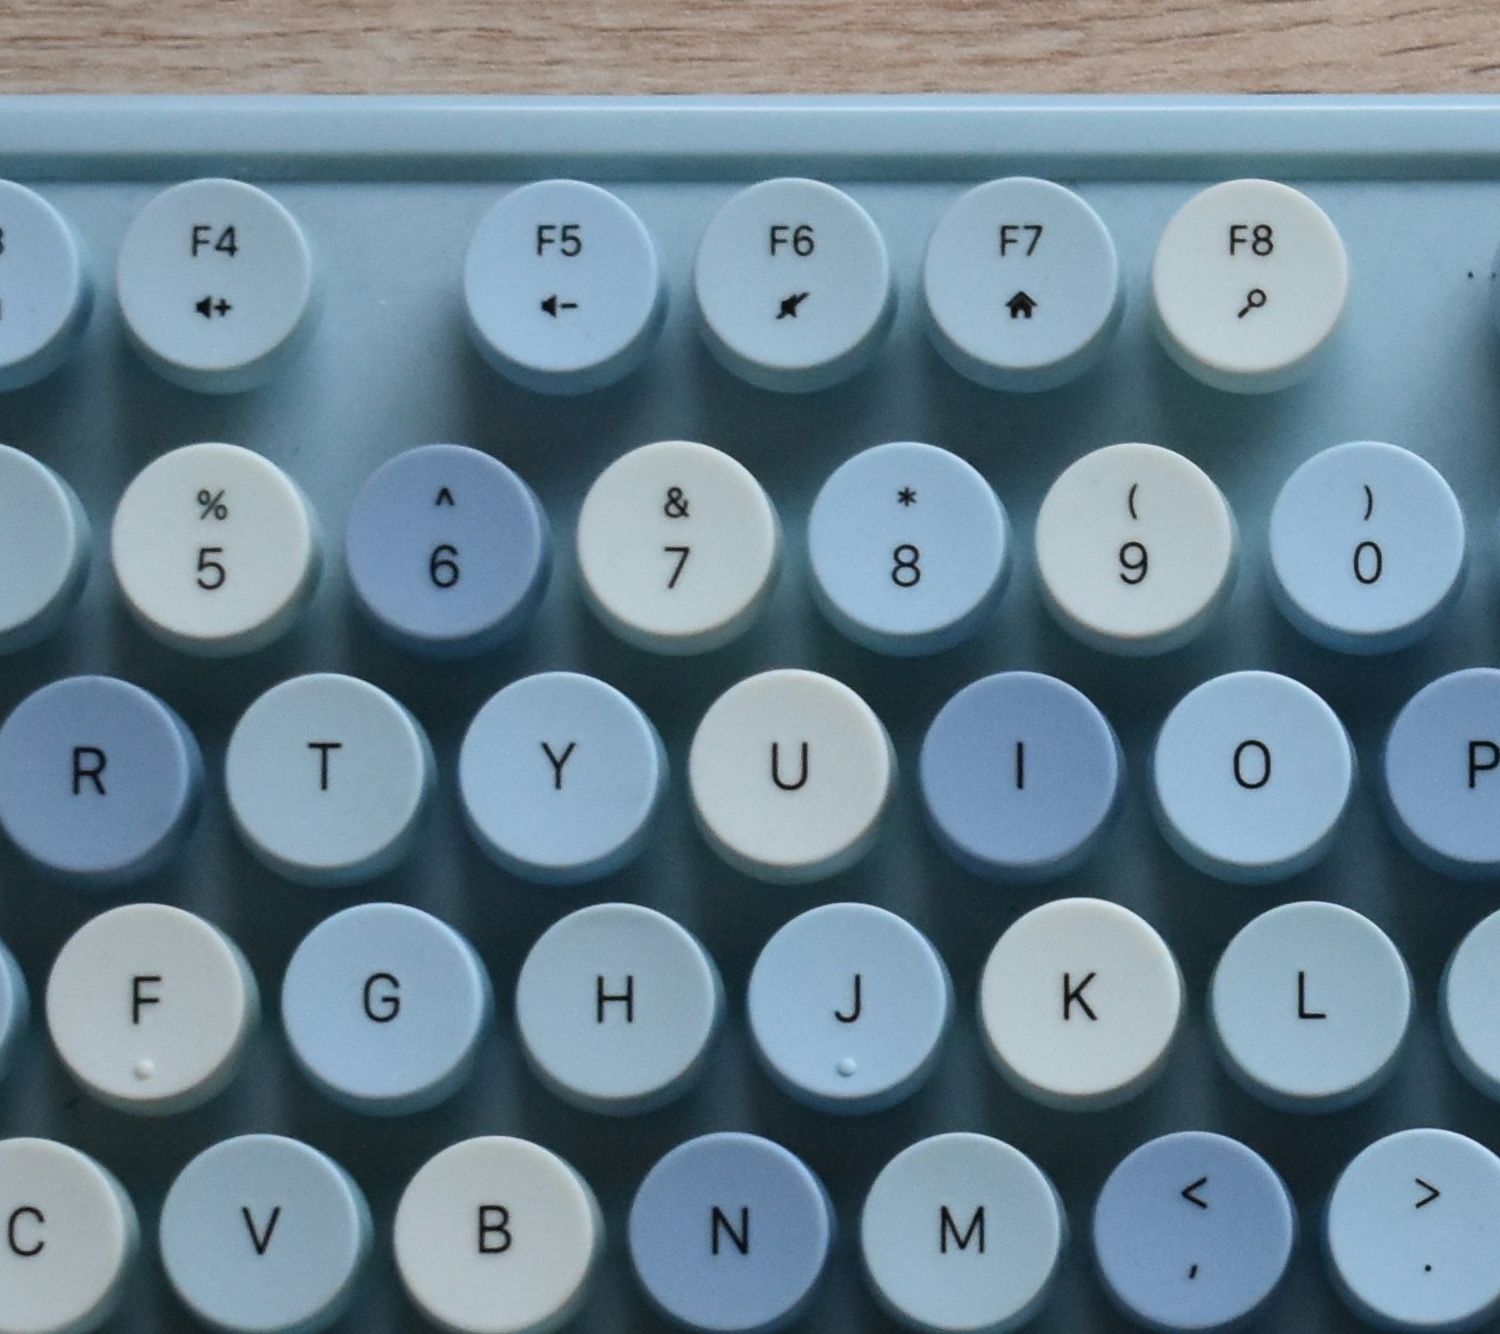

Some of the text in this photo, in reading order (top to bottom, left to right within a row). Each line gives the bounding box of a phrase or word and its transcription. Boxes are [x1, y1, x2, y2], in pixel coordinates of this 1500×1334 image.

[191, 225, 238, 257] F4
[537, 224, 582, 257] F5
[770, 224, 814, 257] F6
[1000, 224, 1043, 256] F7
[1229, 224, 1274, 257] F8
[197, 489, 228, 520] %
[435, 487, 454, 506] ^
[663, 486, 689, 519] &
[1127, 483, 1138, 520] (
[1363, 484, 1374, 521] )
[197, 547, 226, 591] 5
[429, 544, 460, 589] 6
[664, 546, 690, 589] 7
[891, 544, 921, 588] 8
[1119, 541, 1148, 585] 9
[1353, 541, 1383, 585] 0
[72, 746, 107, 795] R
[307, 742, 342, 791] T
[541, 742, 576, 790] Y
[771, 742, 809, 791] U
[1015, 740, 1025, 791] I
[1233, 739, 1271, 790] O
[1468, 740, 1500, 789] P
[131, 975, 161, 1025] F
[363, 972, 400, 1023] G
[596, 975, 634, 1023] H
[834, 974, 862, 1024] J
[1063, 972, 1097, 1021] K
[1297, 971, 1326, 1020] L
[1181, 1177, 1208, 1209] <
[1415, 1178, 1440, 1209] >
[7, 1206, 45, 1258] C
[241, 1207, 281, 1256] V
[478, 1204, 512, 1254] B
[711, 1206, 749, 1256] N
[940, 1205, 985, 1254] M
